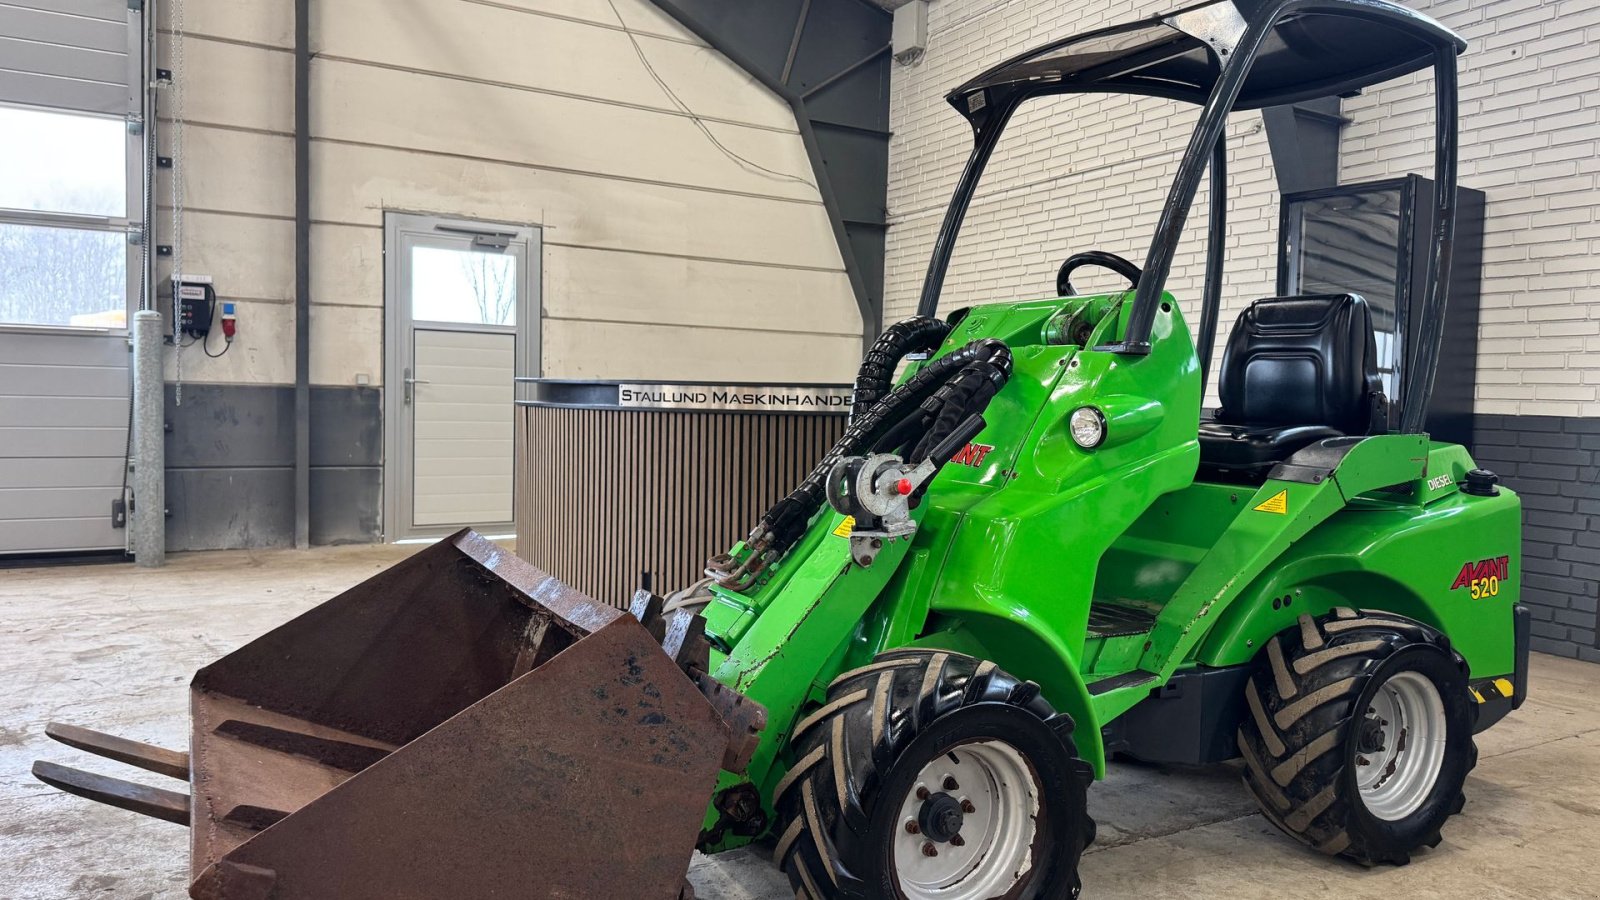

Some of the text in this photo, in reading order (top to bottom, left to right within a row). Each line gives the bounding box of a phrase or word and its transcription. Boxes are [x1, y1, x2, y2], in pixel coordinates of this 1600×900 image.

[621, 389, 852, 407] STAULUND MASKINHANDE
[1427, 474, 1453, 491] DIESEL
[1450, 555, 1509, 590] AVANT
[1470, 575, 1499, 600] 520
